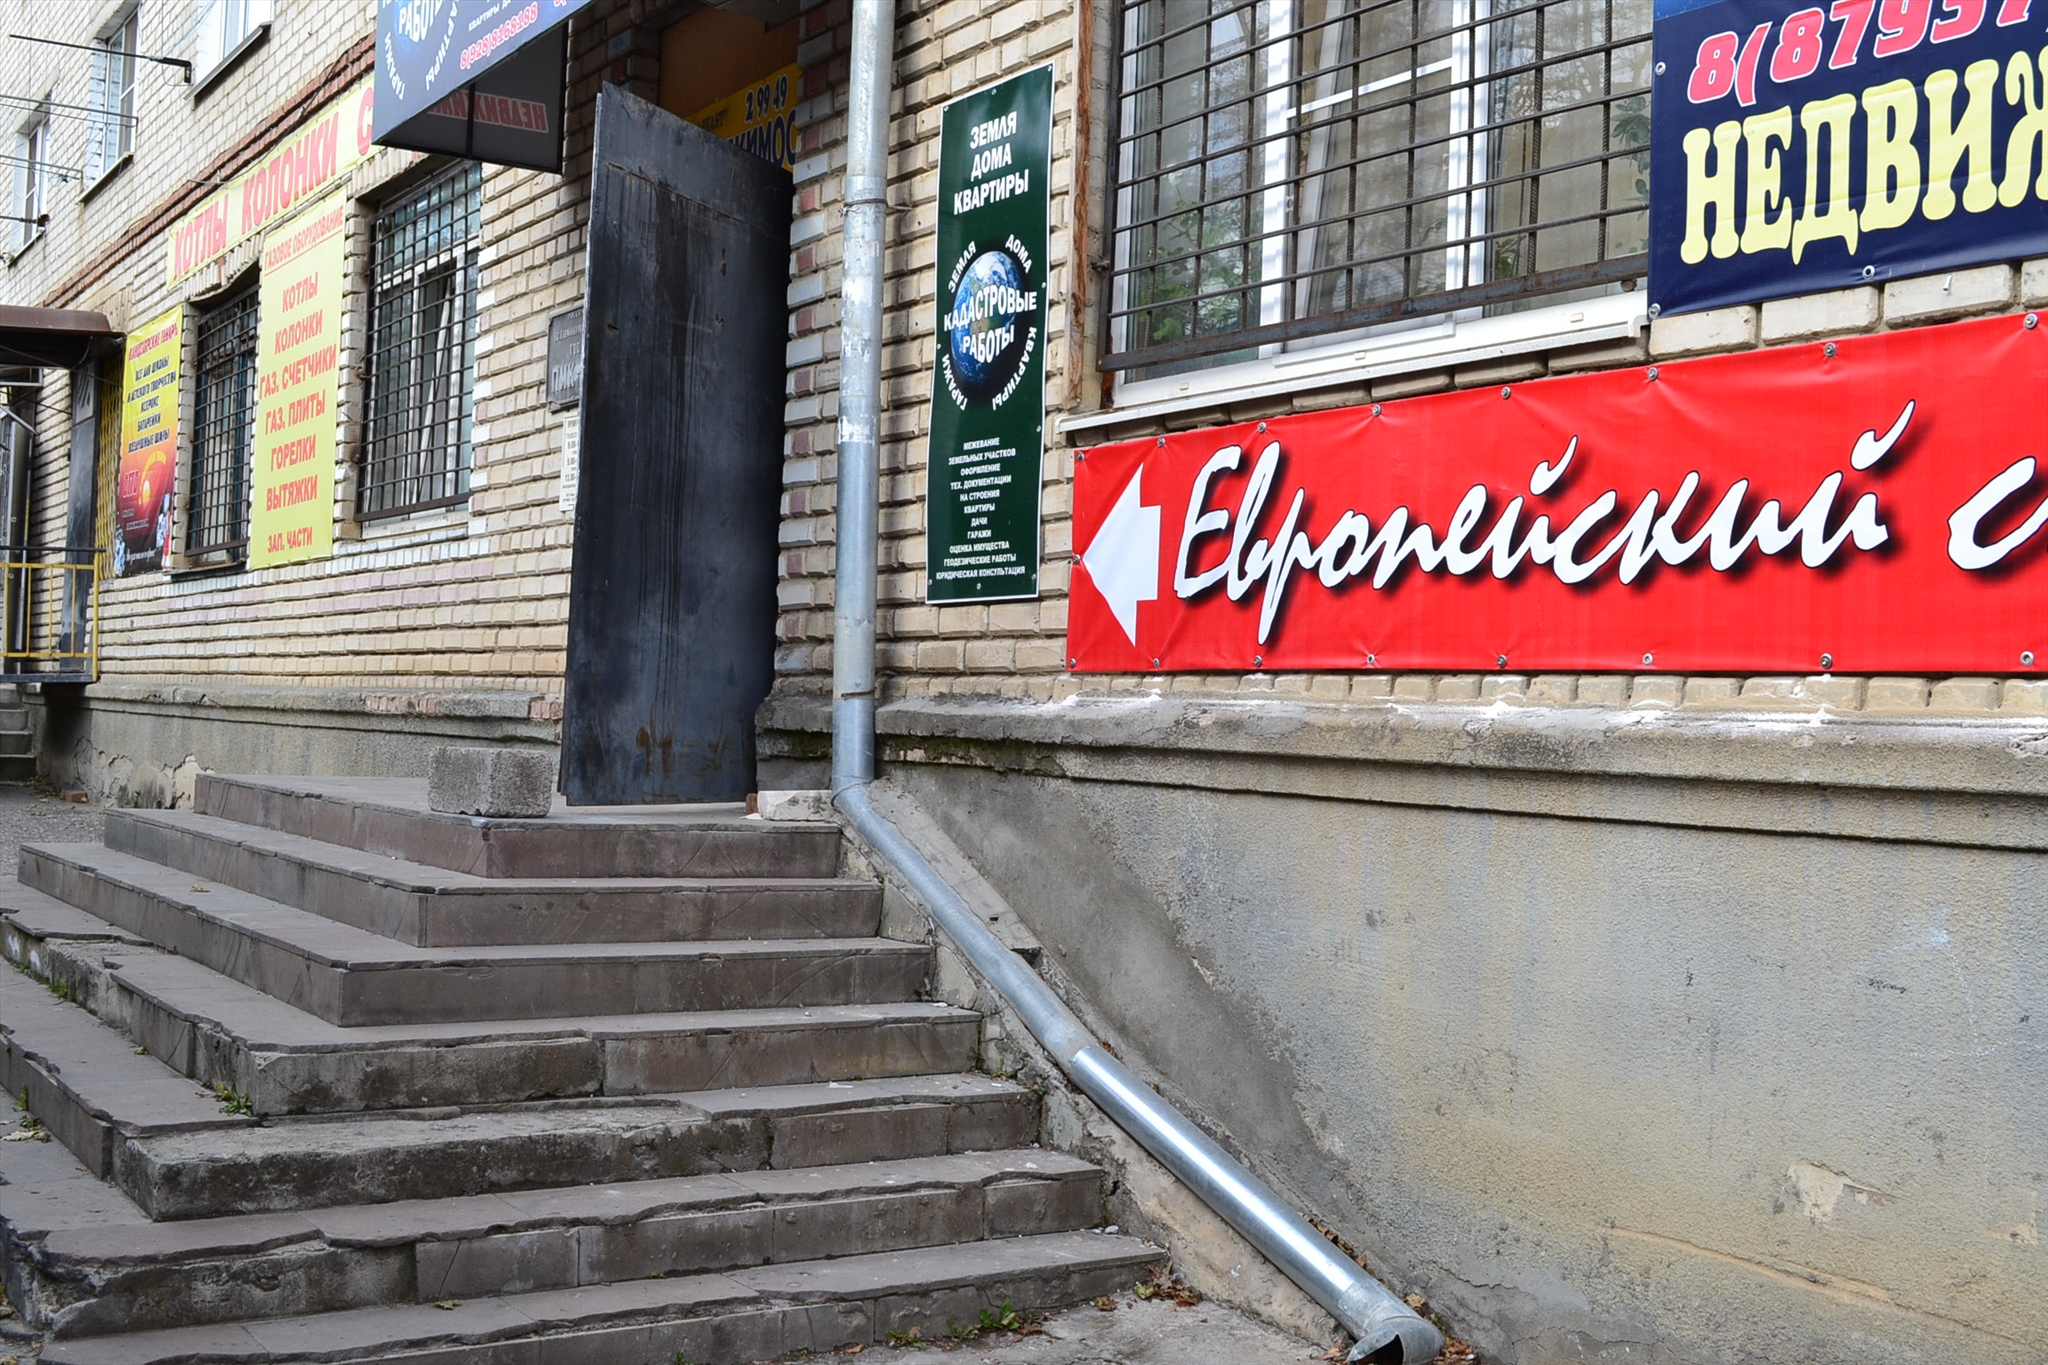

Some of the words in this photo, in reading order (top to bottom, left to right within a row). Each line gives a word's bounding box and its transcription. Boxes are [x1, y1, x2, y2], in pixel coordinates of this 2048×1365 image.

[398, 0, 443, 43] РАБОТ
[468, 3, 500, 31] КВАРТИРЫ
[425, 0, 458, 91] АРТИРЫ
[384, 31, 406, 100] ГАРАЖИ
[970, 111, 1017, 149] ЗЕМЛЯ
[970, 143, 1012, 181] ДОМА
[173, 193, 230, 281] КОТЛЫ
[241, 112, 340, 235] КОЛОНКИ
[953, 169, 1029, 215] КВАРТИРЫ
[264, 240, 293, 272] ГАЗОВОЕ
[292, 205, 344, 254] ОБОРУДОВАНИЕ
[1005, 234, 1033, 274] ДОМА
[948, 241, 977, 293] ЗЕМЛЯ
[282, 271, 318, 313] КОТЛЫ
[944, 284, 1037, 332] КАДАСТРОВЫЕ
[275, 309, 323, 355] КОЛОНКИ
[962, 324, 1015, 363] РАБОТЫ
[259, 369, 280, 400] ГАЗ.
[282, 343, 338, 391] СЧЕТЧИКИ
[942, 353, 968, 411] ГАРАЖИ
[992, 326, 1038, 411] КВАРТИРЫ
[265, 405, 286, 435] ГАЗ.
[288, 389, 325, 426] ПЛИТЫ
[270, 434, 316, 472] ГОРЕЛКИ
[948, 453, 983, 466] ЗЕМЕЛЬНЫХ
[984, 448, 1016, 462] УЧАСТКОВ
[963, 437, 1000, 450] МЕЖЕВАНИЕ
[950, 480, 963, 490] ТЕХ.
[963, 475, 1012, 489] ДОКУМЕНТАЦИИ
[960, 463, 1001, 476] ОФОРМЛЕНИЕ
[266, 474, 318, 512] ВЫТЯЖКИ
[959, 492, 969, 502] НА
[969, 489, 1000, 501] СТРОЕНИЯ
[964, 503, 995, 514] КВАРТИРЫ
[267, 533, 286, 554] ЗАП.
[287, 526, 313, 550] ЧАСТИ
[967, 529, 991, 540] ГАРАЖИ
[971, 517, 987, 527] ДАЧИ
[1173, 399, 1917, 646] Европейский
[944, 555, 991, 567] ГЕОДЕЗИЧЕСКИЕ
[991, 553, 1016, 564] РАБОТЫ
[949, 544, 973, 554] ОЦЕНКА
[973, 541, 1010, 553] ИМУЩЕСТВА
[936, 568, 978, 580] ЮРИДИЧЕСКАЯ
[979, 565, 1025, 578] КОНСУЛЬТАЦИЯ
